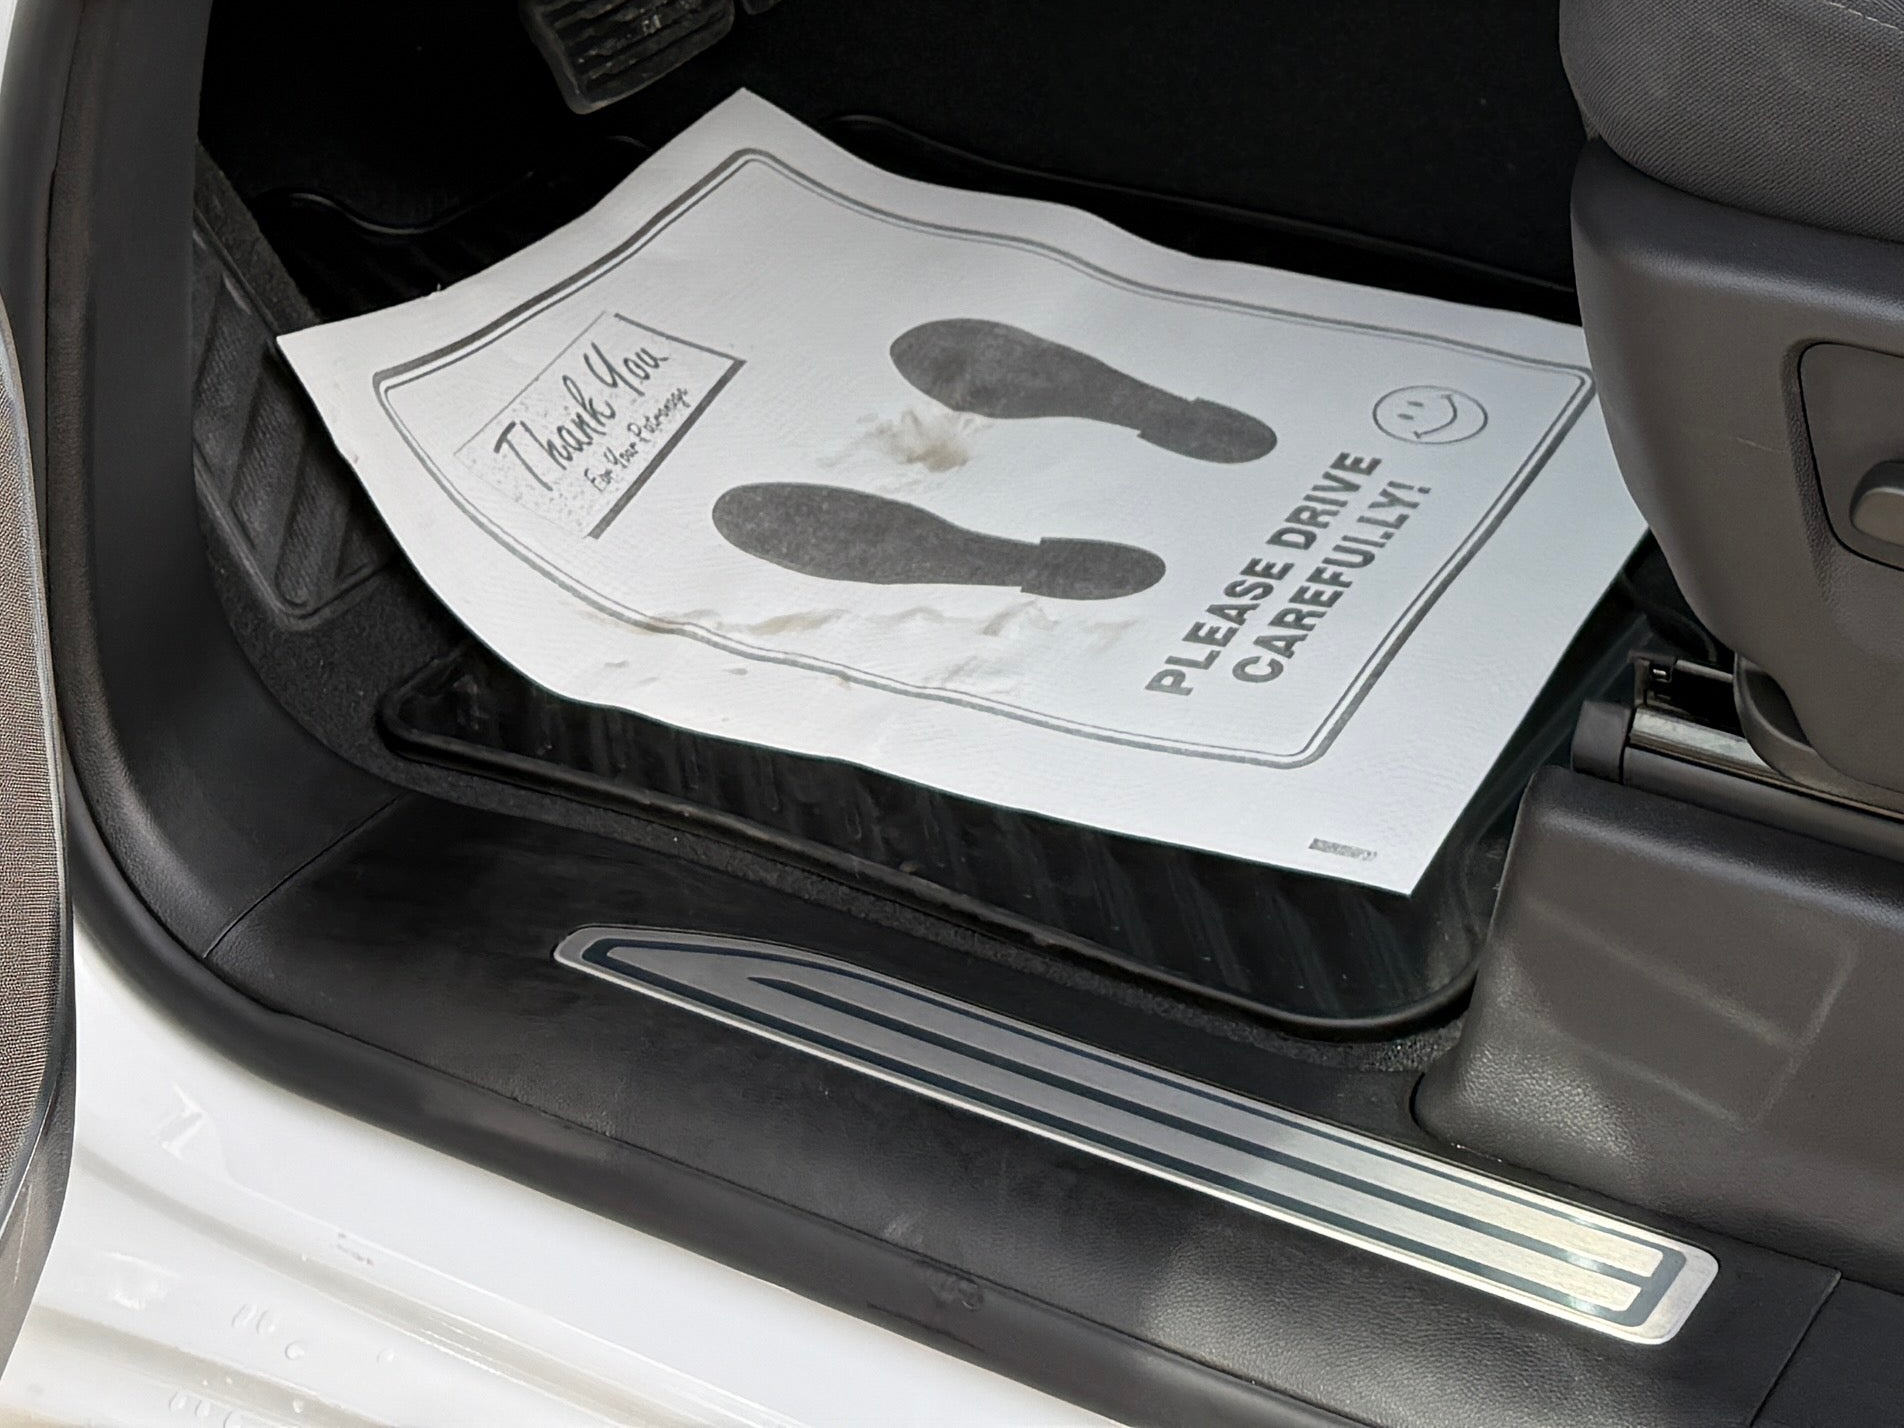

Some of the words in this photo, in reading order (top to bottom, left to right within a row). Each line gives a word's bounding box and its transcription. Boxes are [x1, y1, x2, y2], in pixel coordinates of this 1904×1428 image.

[493, 373, 617, 492] Thank
[583, 341, 670, 398] You
[583, 466, 615, 492] For
[603, 442, 638, 470] Your
[1144, 556, 1296, 697] PLEASE
[1265, 451, 1383, 551] DRIVE
[1231, 479, 1433, 684] CAREFULLY!
